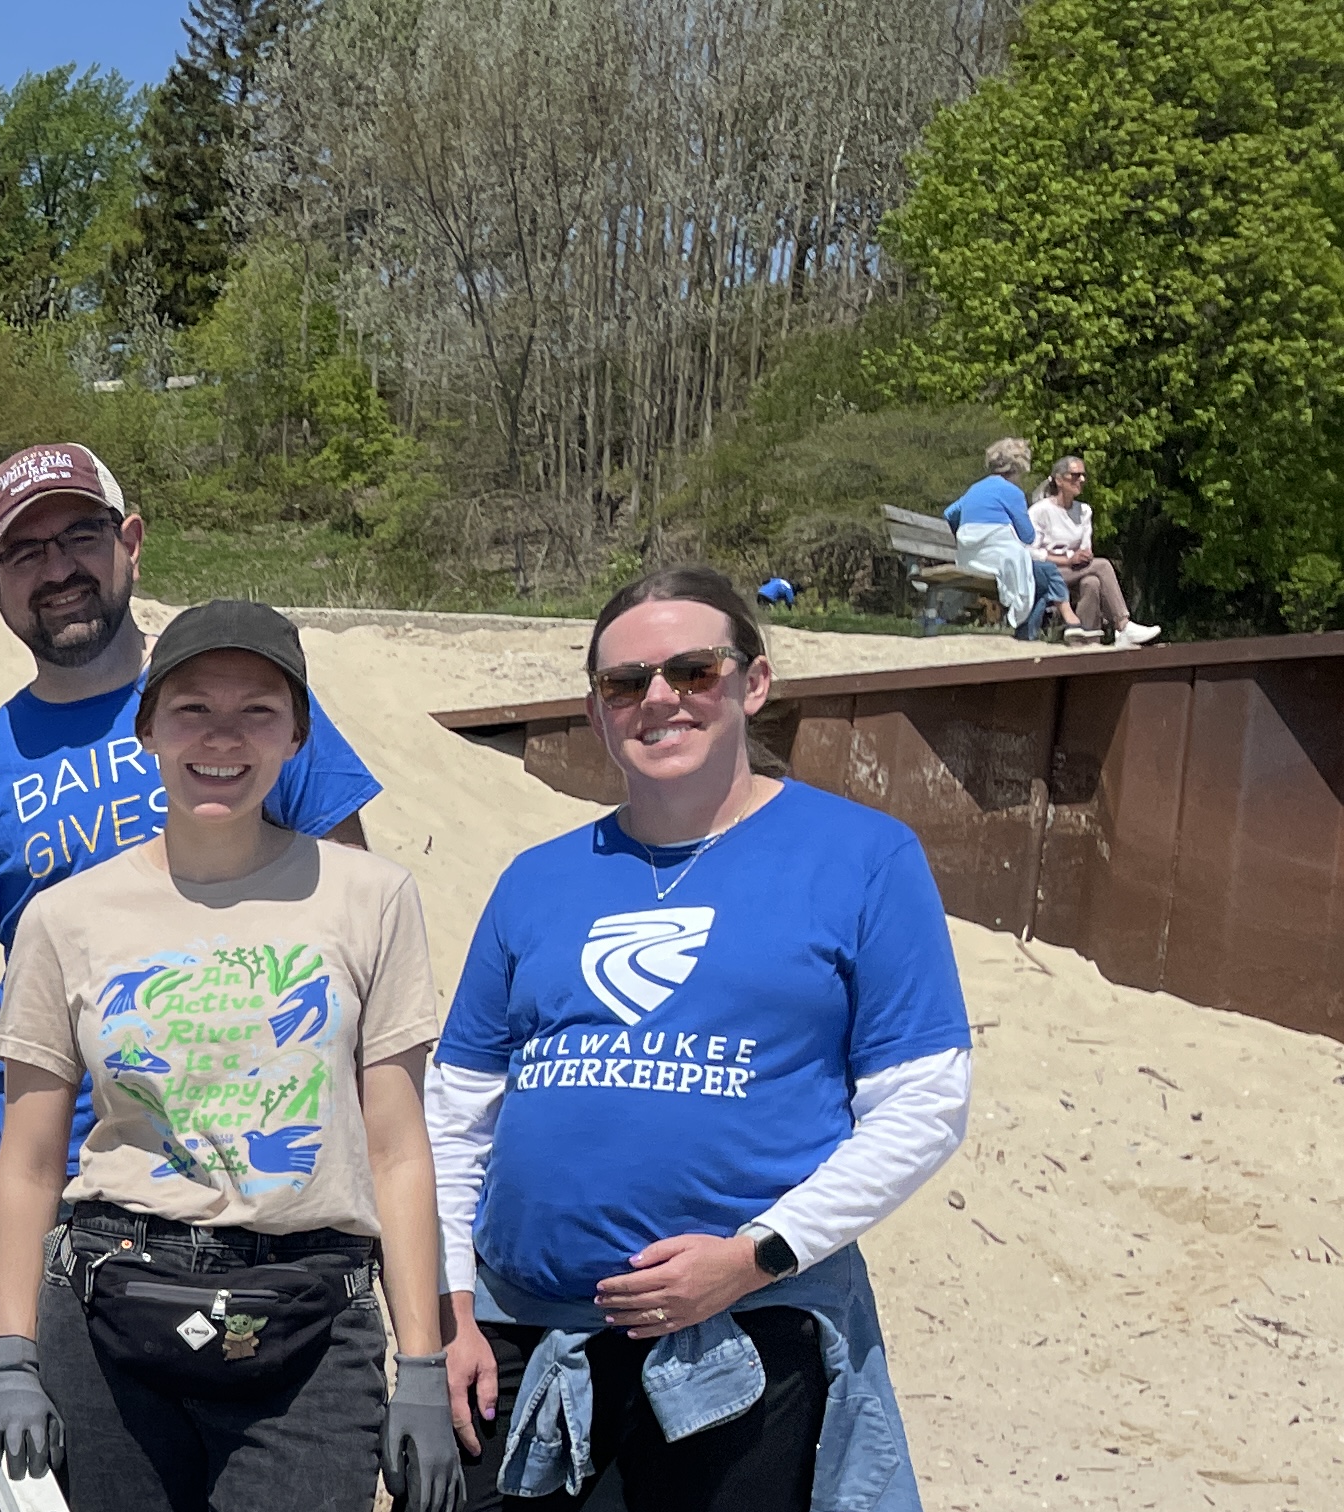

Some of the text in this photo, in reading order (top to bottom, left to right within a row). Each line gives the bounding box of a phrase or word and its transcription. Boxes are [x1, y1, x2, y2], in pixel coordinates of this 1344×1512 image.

[28, 466, 48, 479] INN
[40, 453, 73, 469] STAG
[12, 736, 161, 824] BAIR
[188, 966, 242, 993] An
[152, 992, 266, 1020] Active
[156, 1019, 263, 1051] River
[521, 1030, 757, 1064] MILWAUKEE
[185, 1050, 242, 1073] is a
[163, 1076, 263, 1109] Happy
[169, 1108, 252, 1134] River
